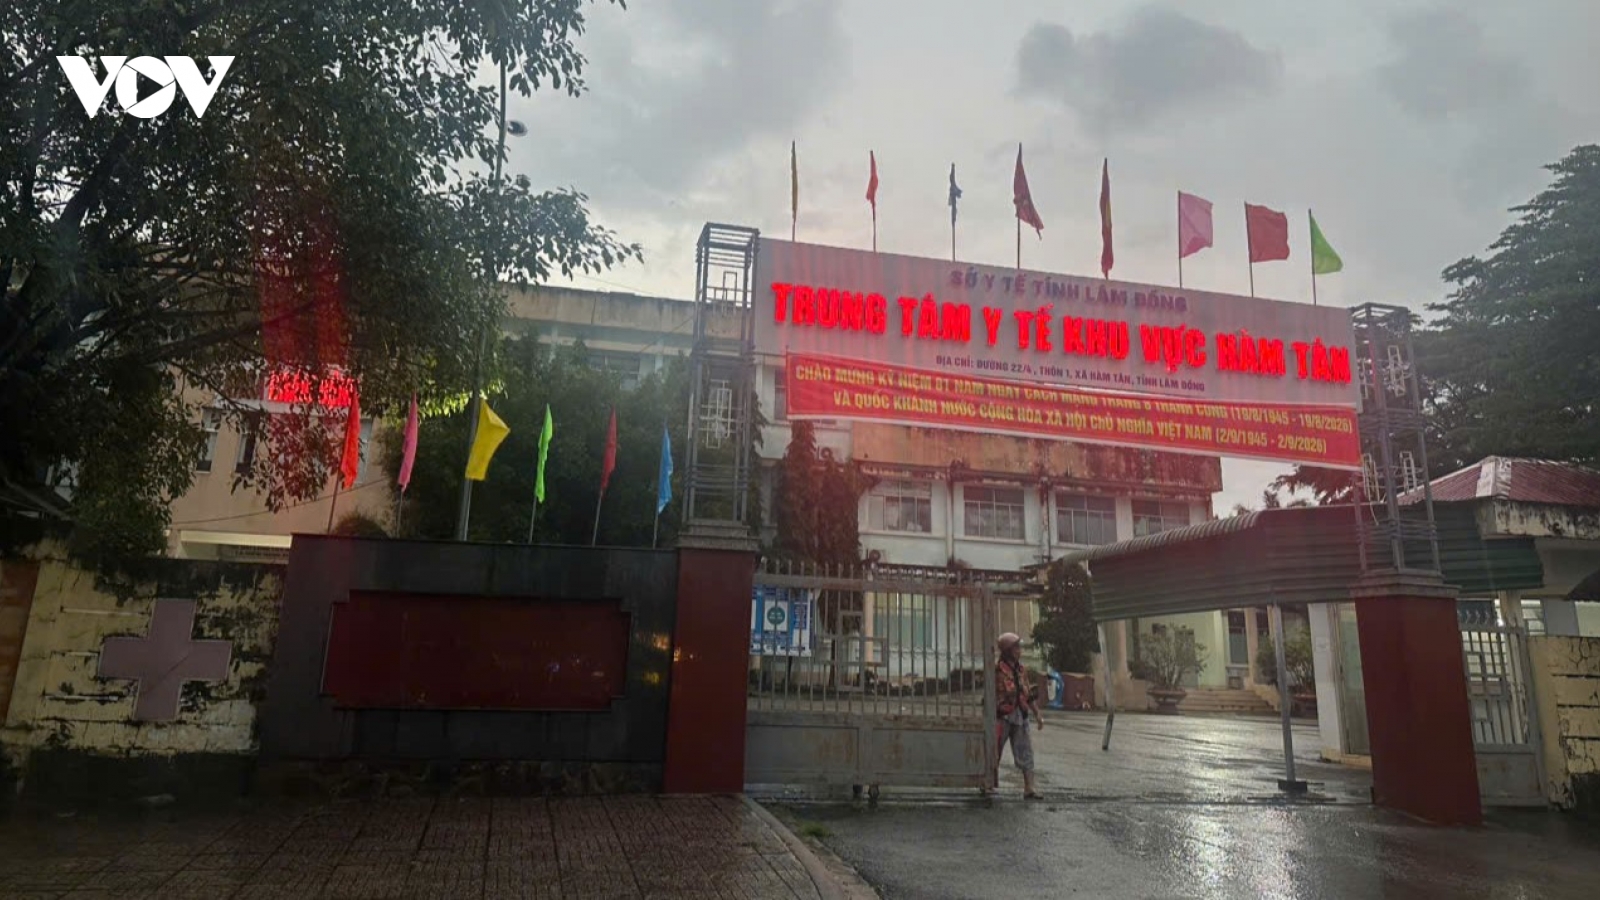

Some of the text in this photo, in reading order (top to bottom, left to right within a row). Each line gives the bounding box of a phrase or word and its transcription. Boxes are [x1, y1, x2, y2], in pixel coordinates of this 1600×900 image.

[951, 266, 1187, 312] SỞ Y TẾ TỈNH LÂM ĐỒNG
[771, 282, 1351, 384] TRUNG TÂM Y TẾ KHU VỰC HÀM TÂN
[795, 363, 831, 381] CHÀO
[835, 365, 874, 385] MỪNG
[898, 372, 932, 391] NIỆM
[1230, 405, 1289, 425] (19/8/1945
[936, 355, 952, 368] ĐỊA
[976, 359, 1009, 372] ĐƯỜNG
[1039, 365, 1063, 378] THÔN
[1075, 369, 1088, 380] XÃ
[1090, 370, 1111, 382] HÀM
[1136, 374, 1157, 387] TỈNH
[1159, 377, 1179, 389] LÂM
[1182, 379, 1205, 391] ĐỒNG
[833, 389, 851, 407] VÀ
[854, 390, 889, 410] QUỐC
[893, 394, 938, 414] KHÁNH
[941, 399, 976, 417] NƯỚC
[979, 401, 1015, 422] CỘNG
[1046, 408, 1063, 427] XÃ
[1065, 410, 1087, 431] HỘI
[1117, 416, 1154, 435] NGHĨA
[1157, 420, 1181, 441] VIỆT
[1184, 423, 1212, 442] NAM
[1215, 427, 1268, 448] (2/9/1945
